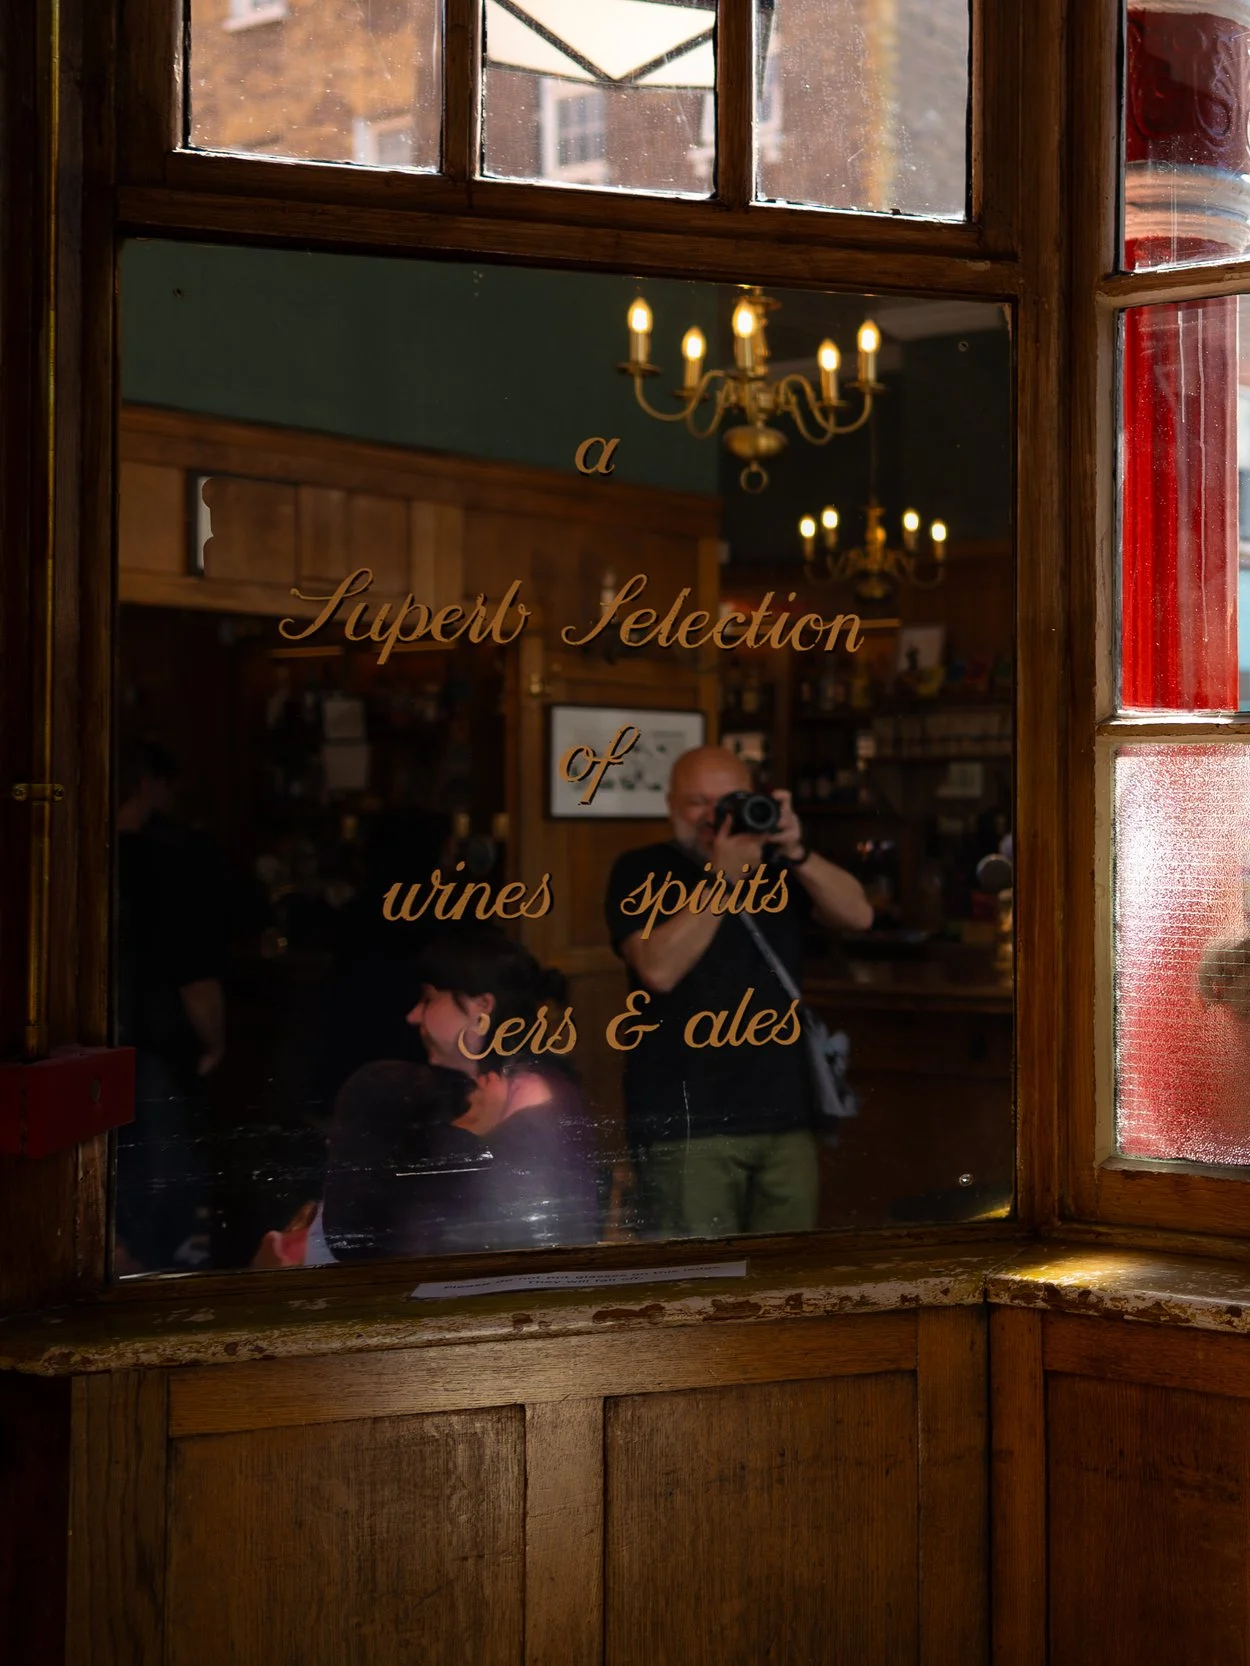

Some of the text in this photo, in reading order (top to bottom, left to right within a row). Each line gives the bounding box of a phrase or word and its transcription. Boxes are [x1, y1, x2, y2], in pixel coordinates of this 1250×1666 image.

[575, 436, 621, 476] a
[278, 567, 865, 665] Superb Selection
[559, 723, 642, 806] of
[382, 861, 790, 940] wines spirits
[605, 990, 662, 1051] &
[683, 987, 802, 1048] ales
